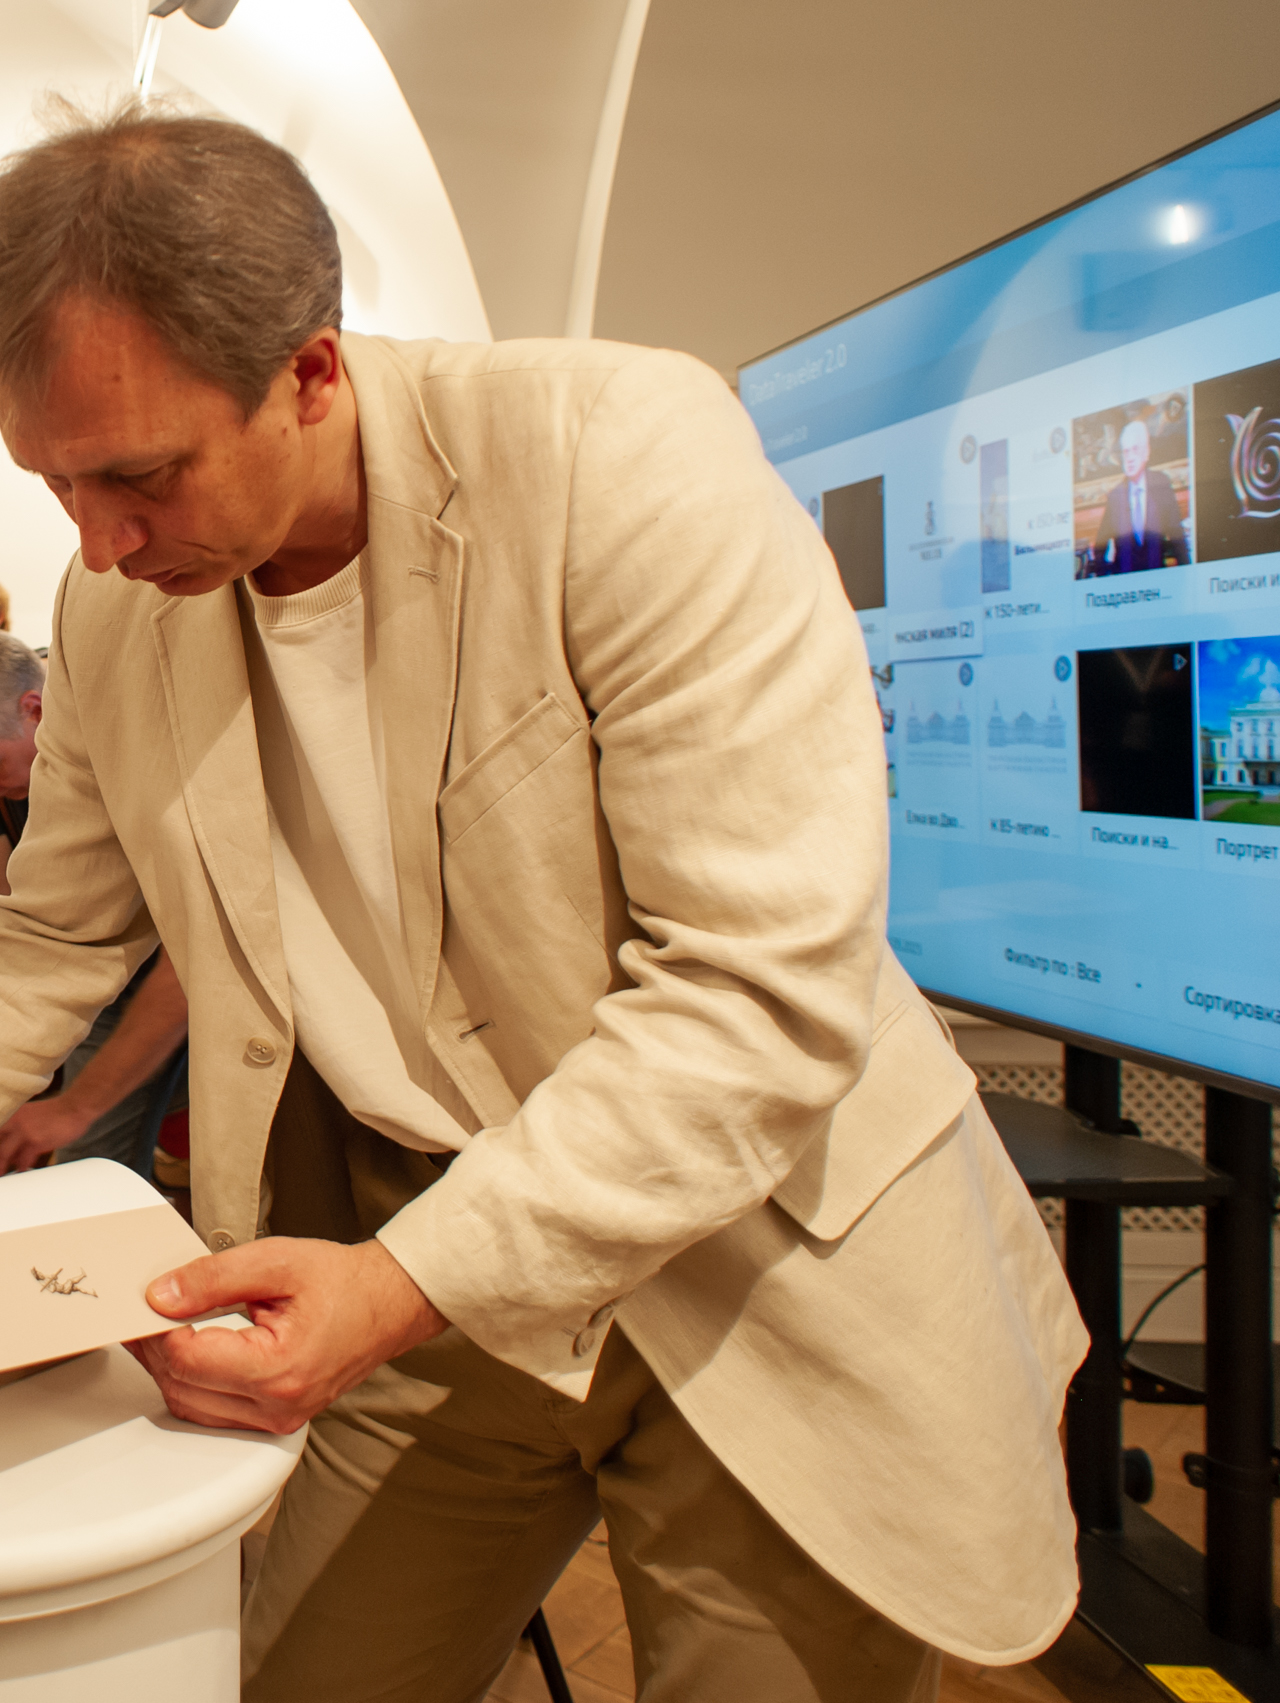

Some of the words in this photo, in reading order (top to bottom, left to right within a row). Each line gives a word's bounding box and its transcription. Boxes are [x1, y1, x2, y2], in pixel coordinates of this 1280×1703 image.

[1208, 575, 1267, 594] Поиски
[1090, 826, 1139, 847] Поиски
[1215, 836, 1279, 863] Портрет
[1004, 946, 1050, 976] Фильтр
